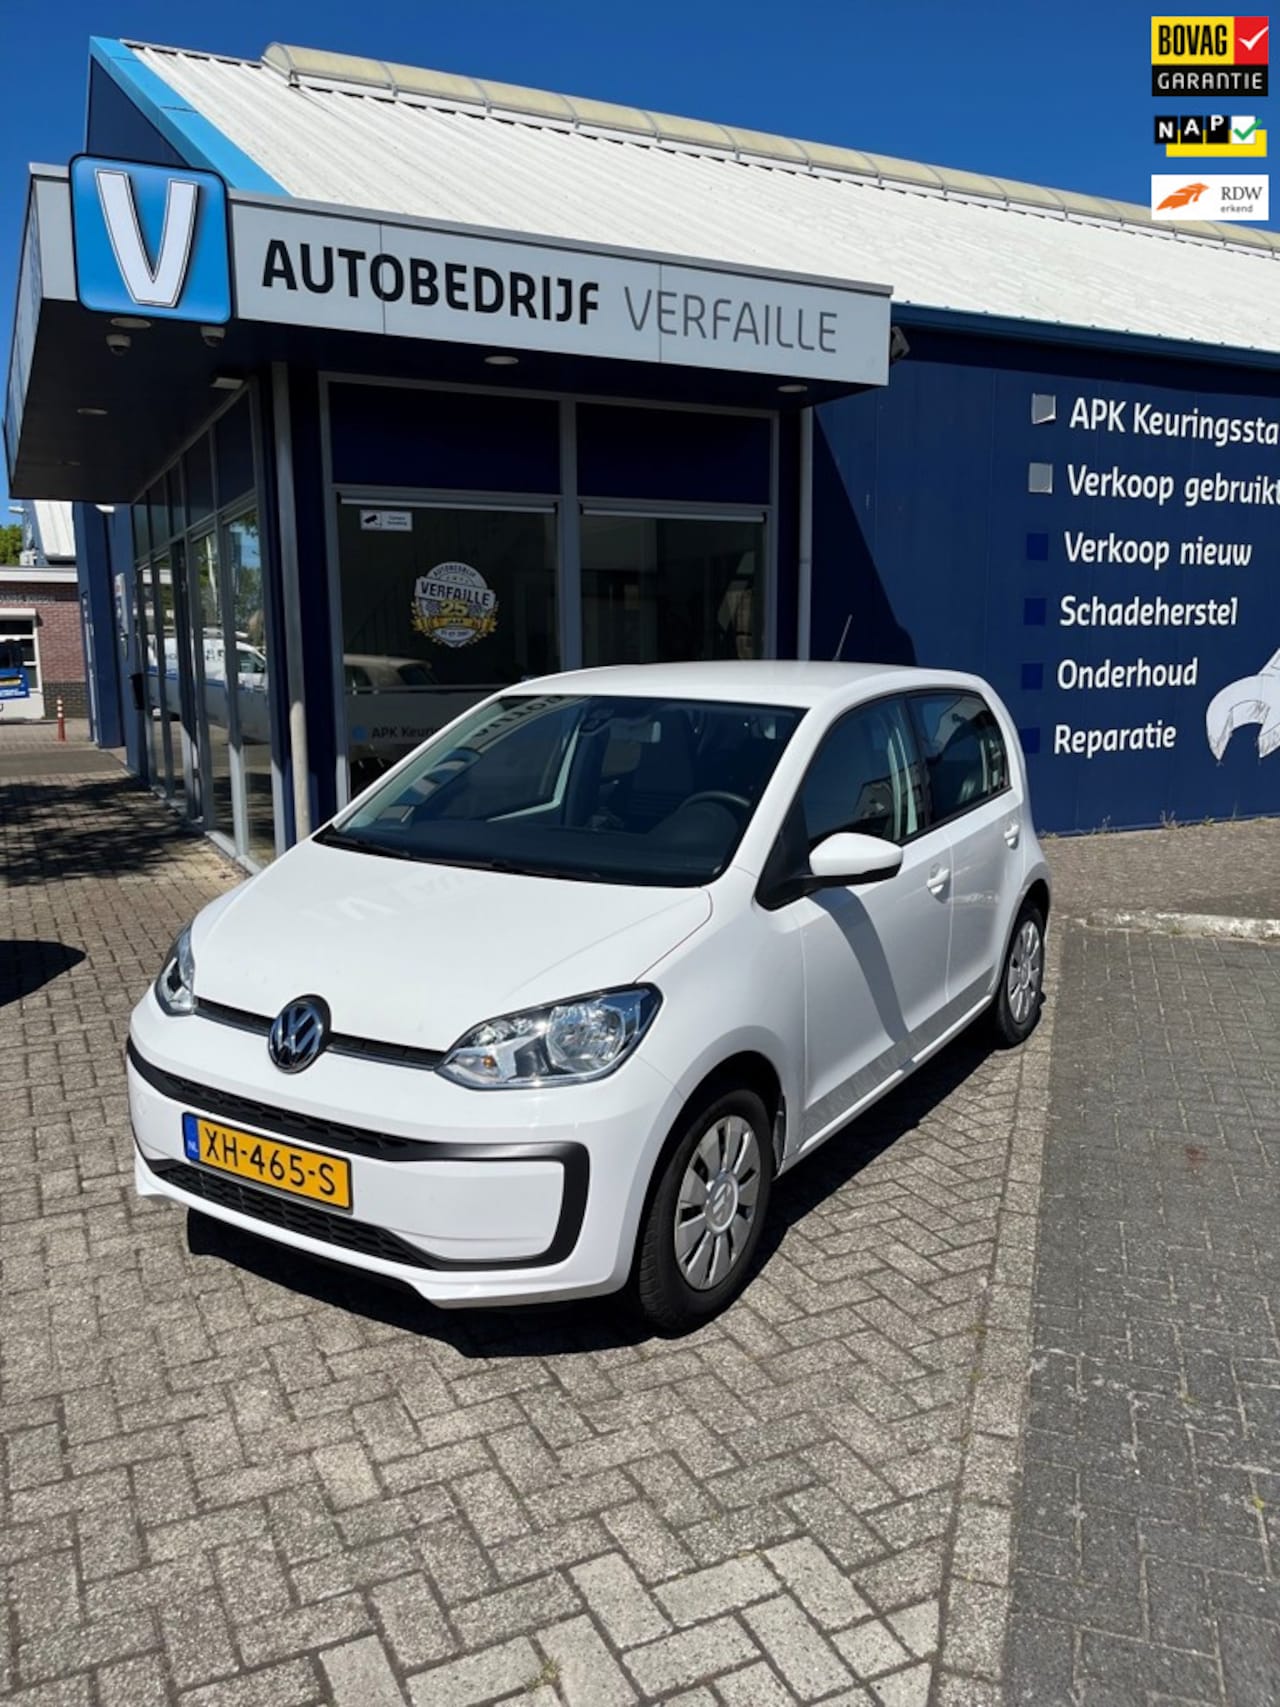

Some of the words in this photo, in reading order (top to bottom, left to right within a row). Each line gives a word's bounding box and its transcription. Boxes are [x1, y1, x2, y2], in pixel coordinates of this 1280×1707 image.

[262, 238, 599, 325] AUTOBEDRIJF
[624, 286, 838, 354] VERFAILLE
[1069, 397, 1127, 433] APK
[1067, 463, 1175, 506] Verkoop
[1064, 530, 1170, 571] Verkoop
[1180, 535, 1252, 566] nieuw
[421, 581, 491, 606] VERFAILLE
[1059, 595, 1239, 627] Schadeherstel
[1056, 656, 1199, 690] Onderhoud
[1053, 719, 1177, 759] Reparatie
[204, 1127, 336, 1196] XH-465-S
